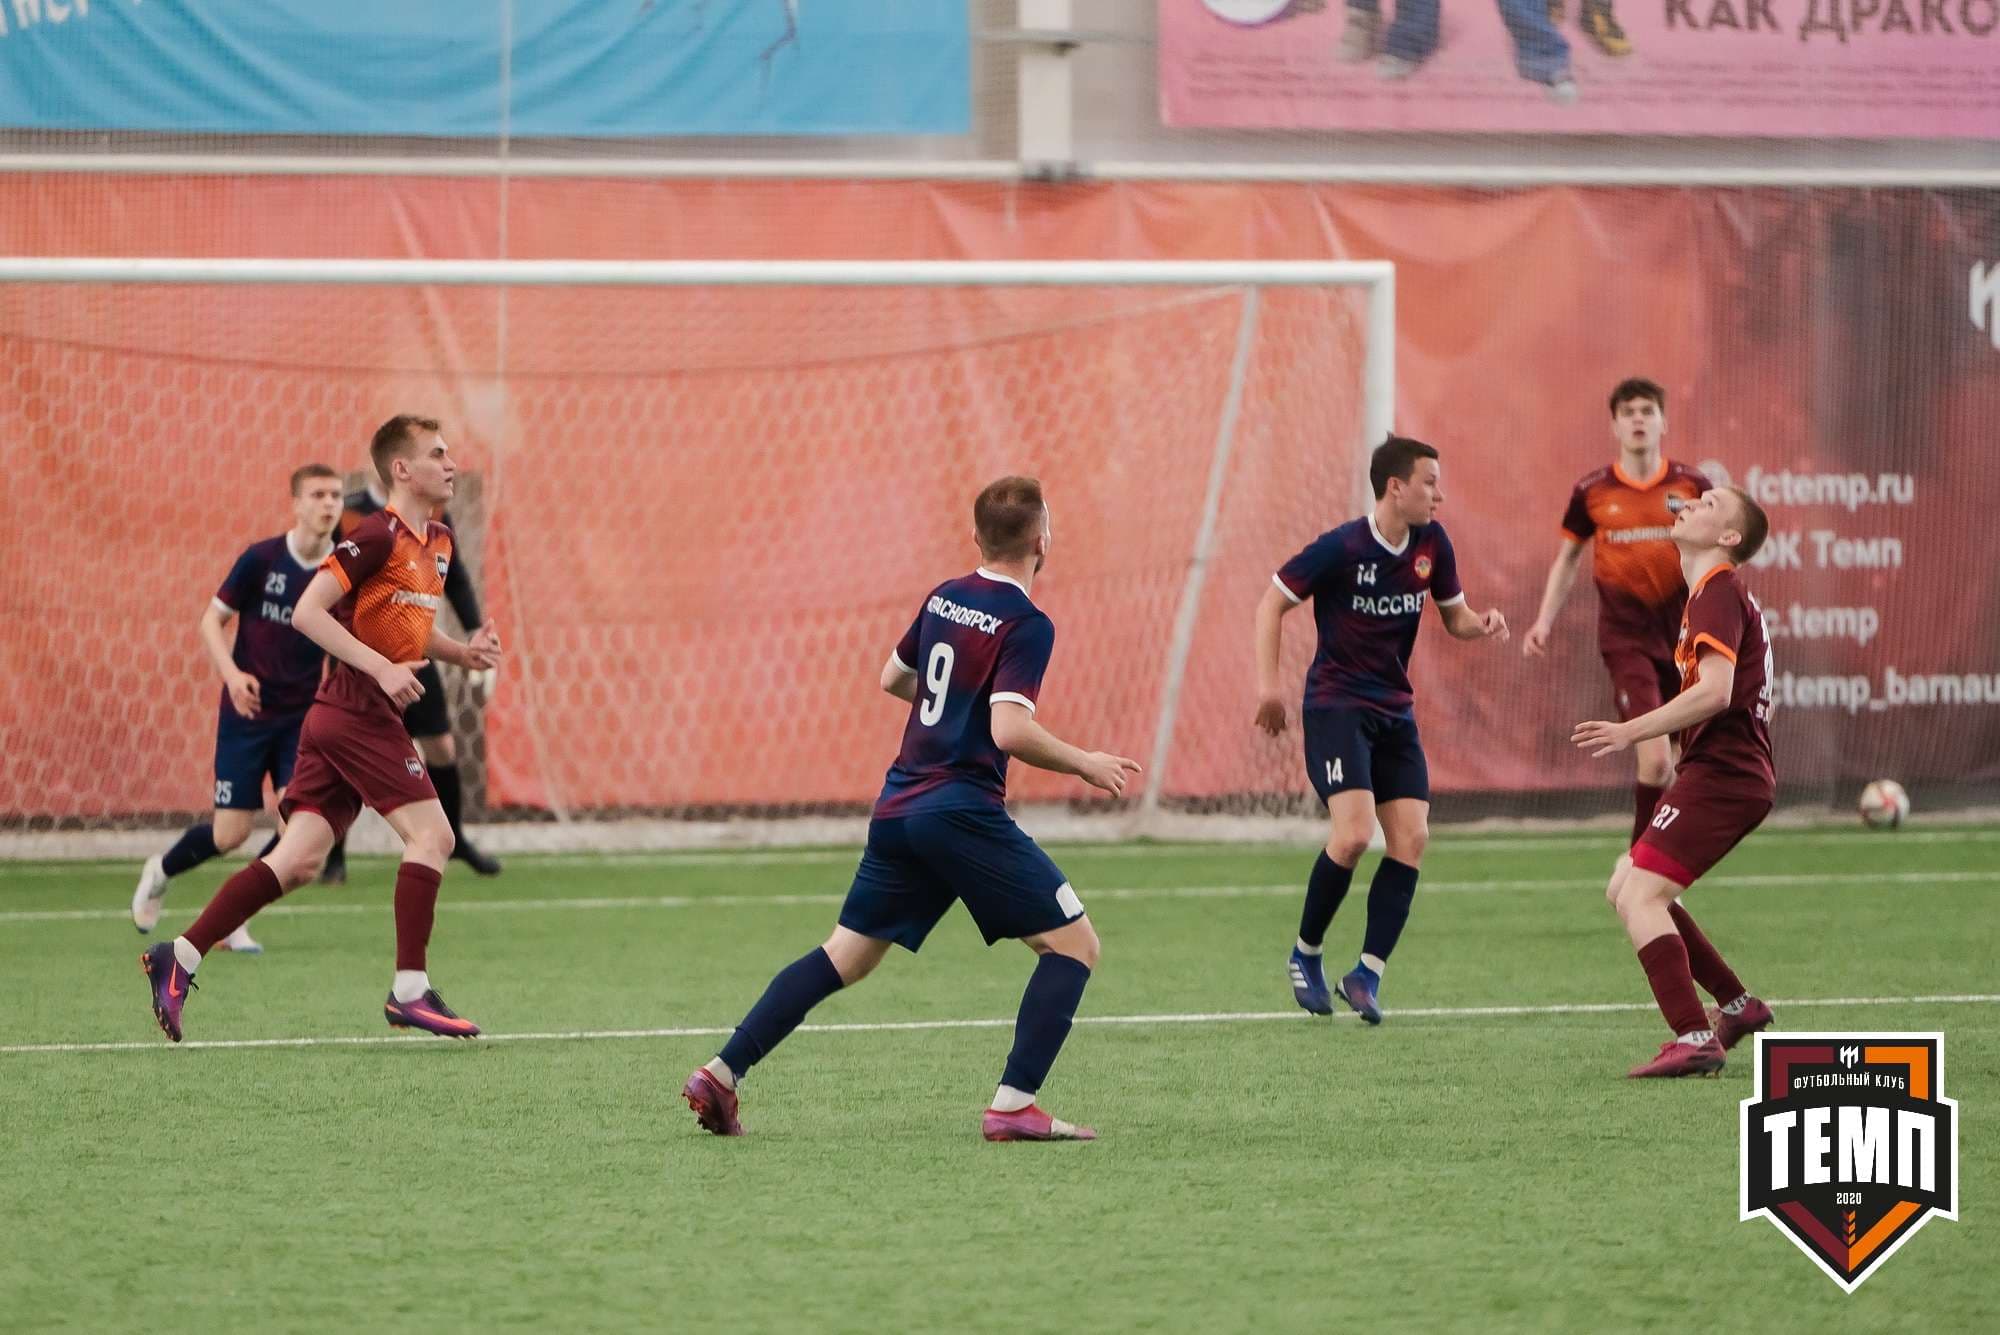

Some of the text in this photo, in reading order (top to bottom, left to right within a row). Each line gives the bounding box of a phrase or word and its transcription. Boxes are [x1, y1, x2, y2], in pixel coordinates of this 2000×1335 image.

[1664, 0, 1780, 32] КАК
[1810, 529, 1904, 569] Темп
[264, 571, 287, 595] 25
[1356, 563, 1377, 586] 14
[919, 641, 954, 727] 9
[1326, 757, 1344, 784] 14
